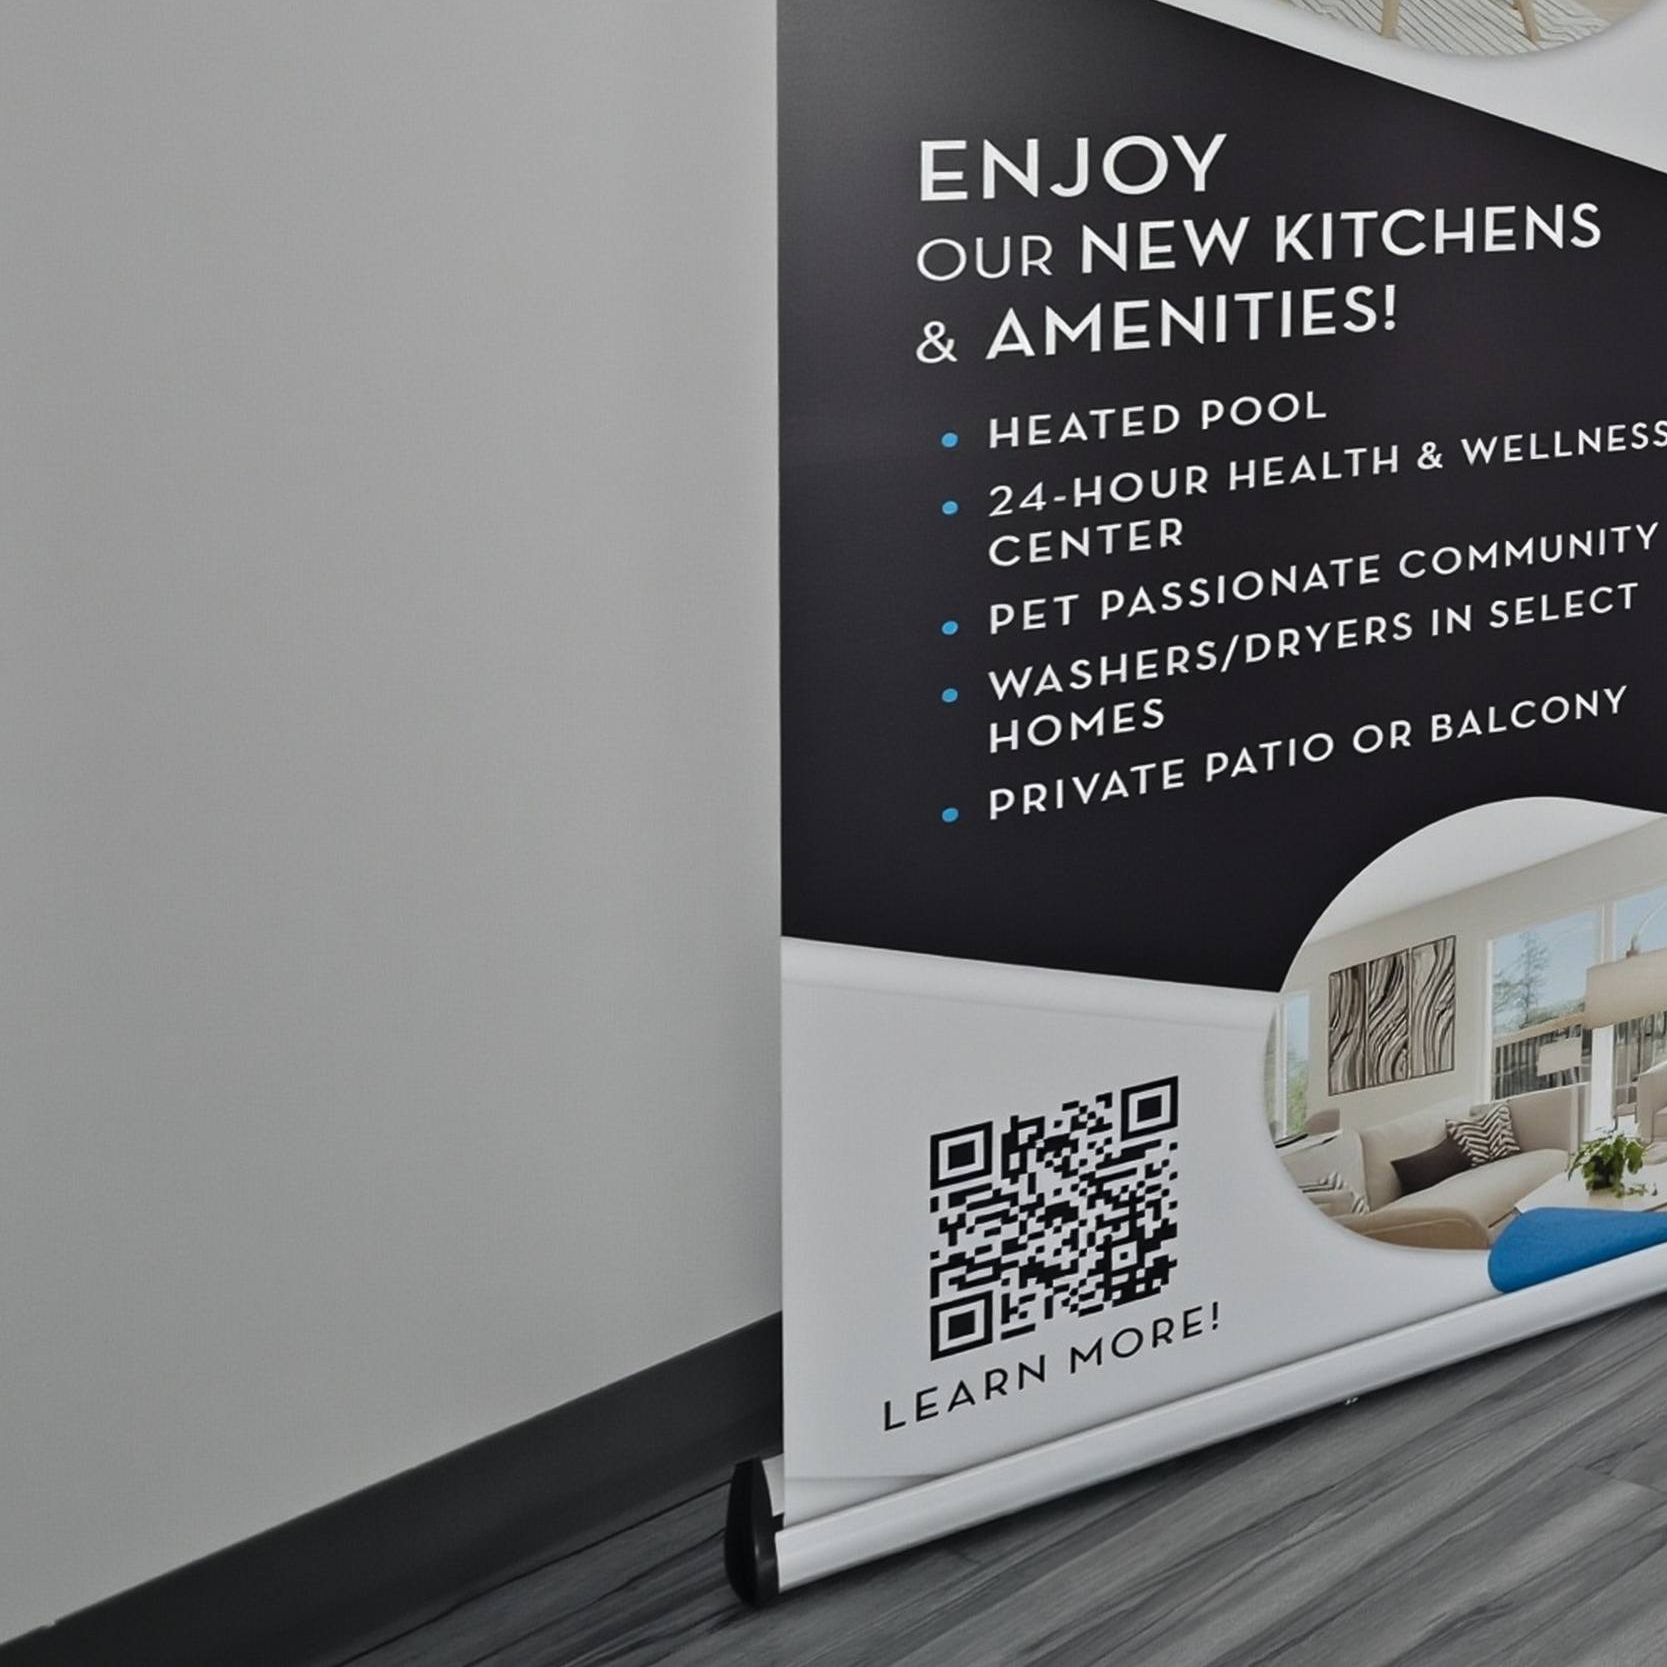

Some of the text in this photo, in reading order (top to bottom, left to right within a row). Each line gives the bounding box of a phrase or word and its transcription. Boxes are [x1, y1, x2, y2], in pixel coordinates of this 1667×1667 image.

[920, 133, 1227, 202] ENJOY
[916, 202, 1601, 282] OUR NEW KITCHENS
[915, 284, 1396, 364] & AMENITIES!
[989, 390, 1327, 449] HEATED POOL
[988, 465, 1209, 517] 24-HOUR
[1229, 444, 1398, 491] HEALTH
[1417, 441, 1444, 470] &
[988, 517, 1183, 567] CENTER
[990, 521, 1659, 635] PET PASSIONATE COMMUNITY
[988, 582, 1639, 701] WASHERS/DRYERS IN SELECT
[989, 698, 1165, 754] HOMES
[989, 684, 1627, 820] PRIVATE PATIO OR BALCONY
[884, 1301, 1219, 1432] LEARN MORE!
